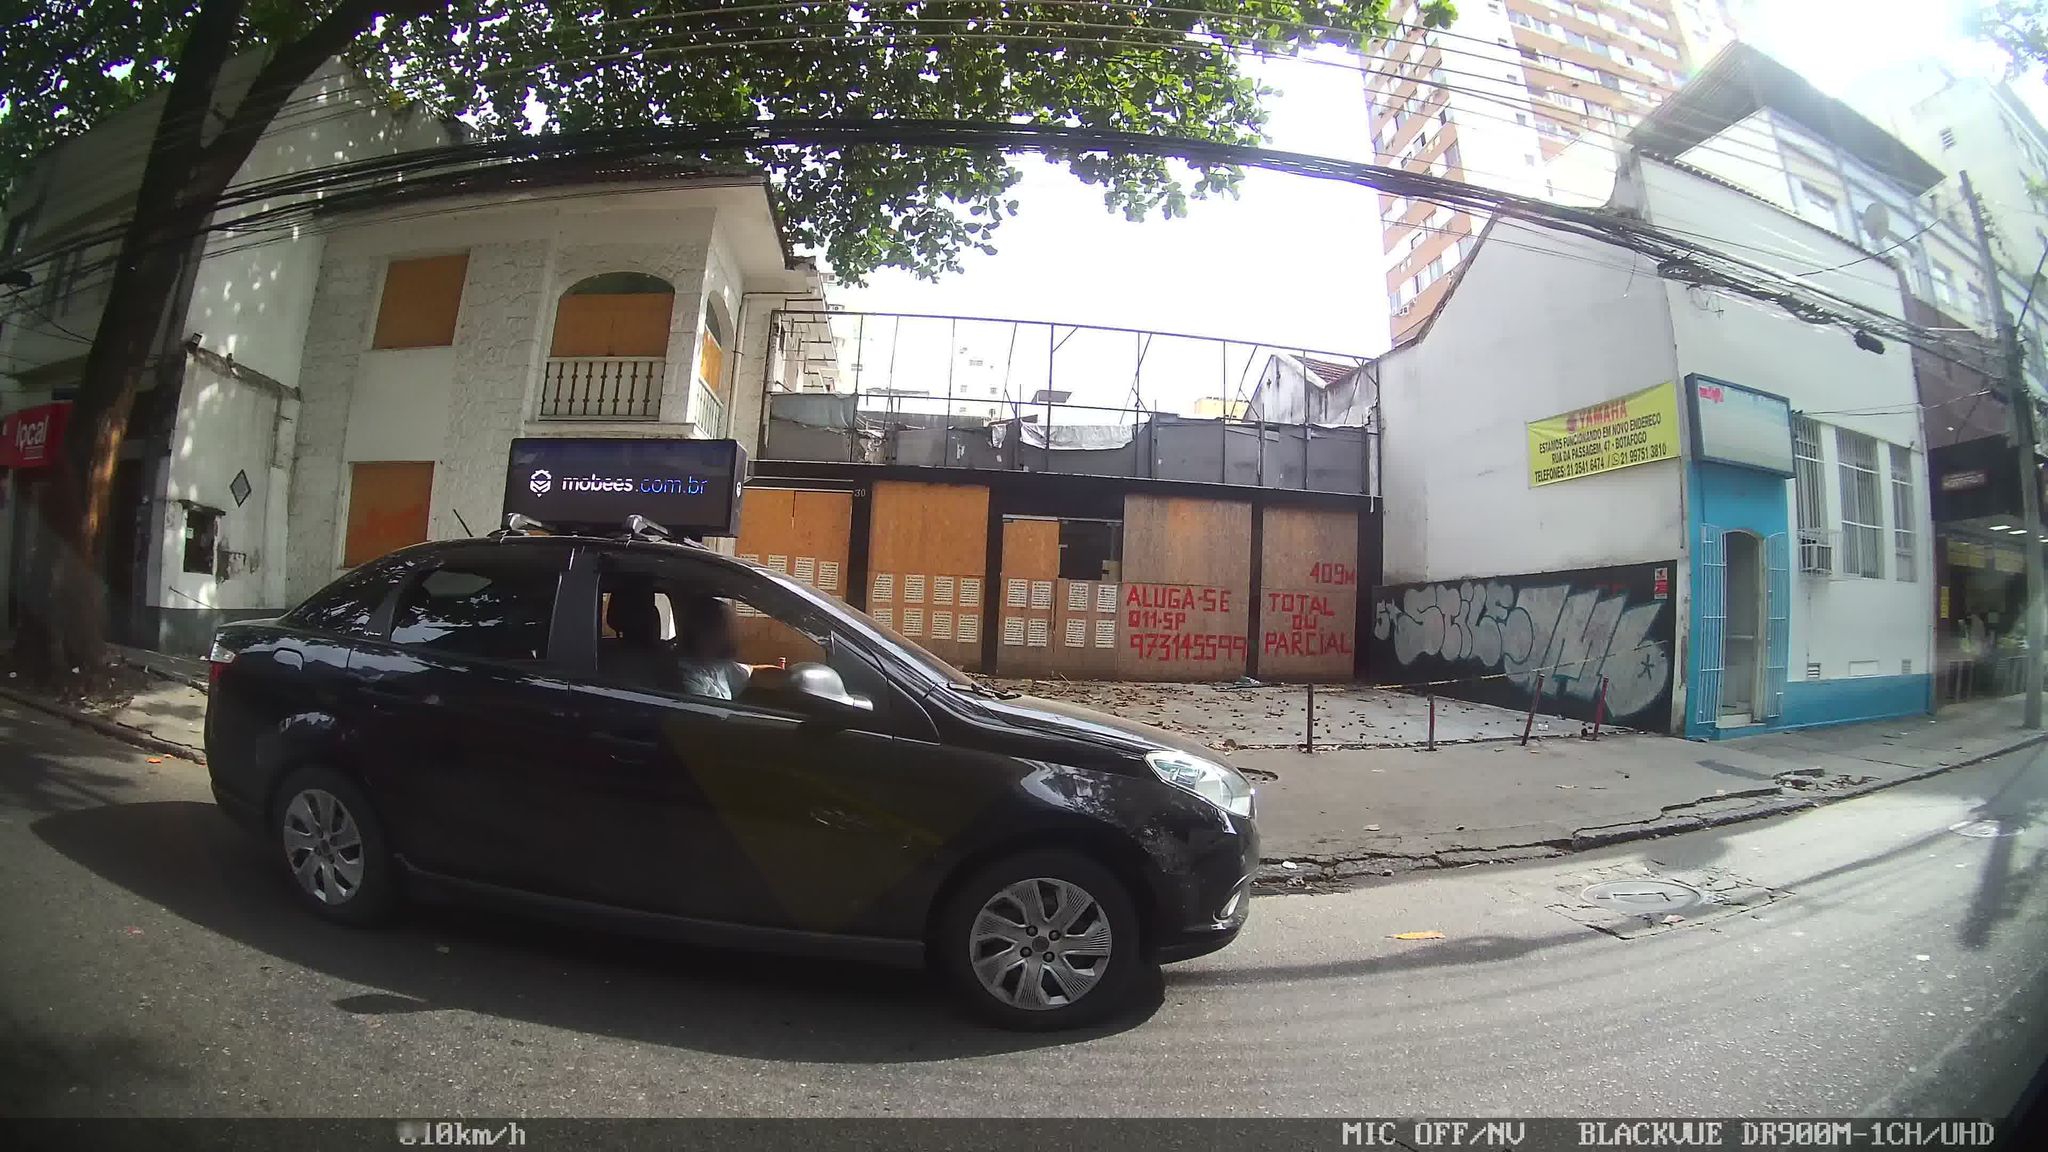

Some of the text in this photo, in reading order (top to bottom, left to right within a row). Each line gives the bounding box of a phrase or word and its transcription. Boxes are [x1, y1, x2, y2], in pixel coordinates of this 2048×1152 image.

[1580, 400, 1628, 429] YAMAHA
[1539, 438, 1563, 454] ESTAMOS
[1563, 428, 1601, 448] FUNCIONANDO
[1602, 426, 1611, 438] EM
[1612, 421, 1629, 436] NOVO
[1551, 451, 1562, 465] RUA
[1563, 450, 1571, 462] DA
[1604, 439, 1611, 453] 47
[1615, 431, 1647, 450] BOTAFOGO
[1566, 462, 1574, 477] 21
[1620, 451, 1629, 466] 21
[1629, 446, 1649, 463] 99751
[562, 473, 707, 496] mobees.com.br
[854, 488, 866, 498] 30
[1126, 584, 1232, 612] ALUGA-SE
[1268, 592, 1335, 617] TOTAL
[1292, 614, 1317, 631] OU
[1130, 632, 1247, 662] 973145599
